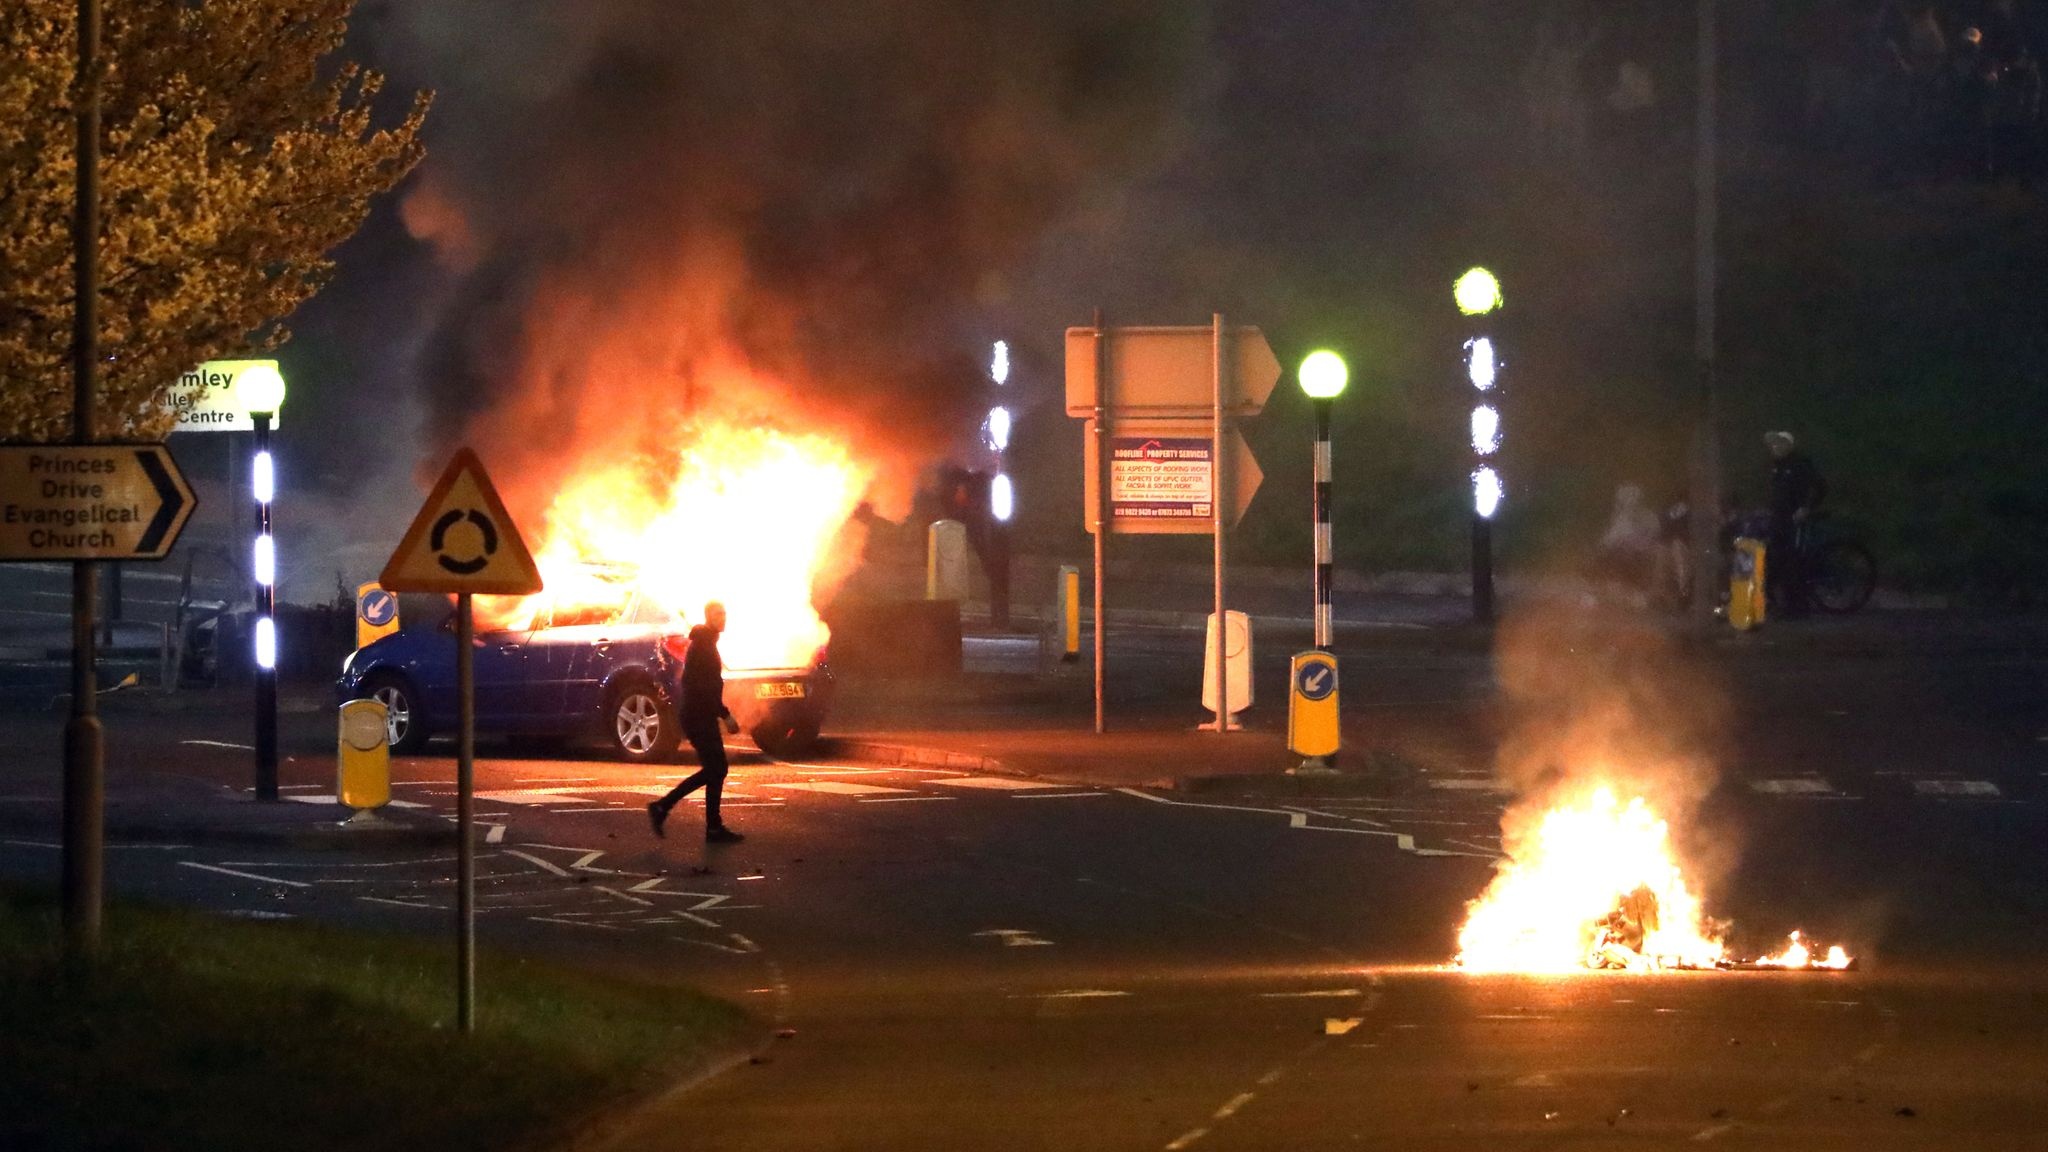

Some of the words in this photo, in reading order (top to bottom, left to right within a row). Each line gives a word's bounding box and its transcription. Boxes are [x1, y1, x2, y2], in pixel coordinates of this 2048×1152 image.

[178, 410, 234, 423] Centre
[1115, 450, 1143, 458] ROOFLINE
[1147, 450, 1178, 458] PROPERTY
[1179, 450, 1208, 458] SERVICES
[29, 455, 116, 473] Princes
[42, 480, 103, 497] Drive
[5, 504, 141, 525] Evangelical
[29, 529, 115, 548] Church
